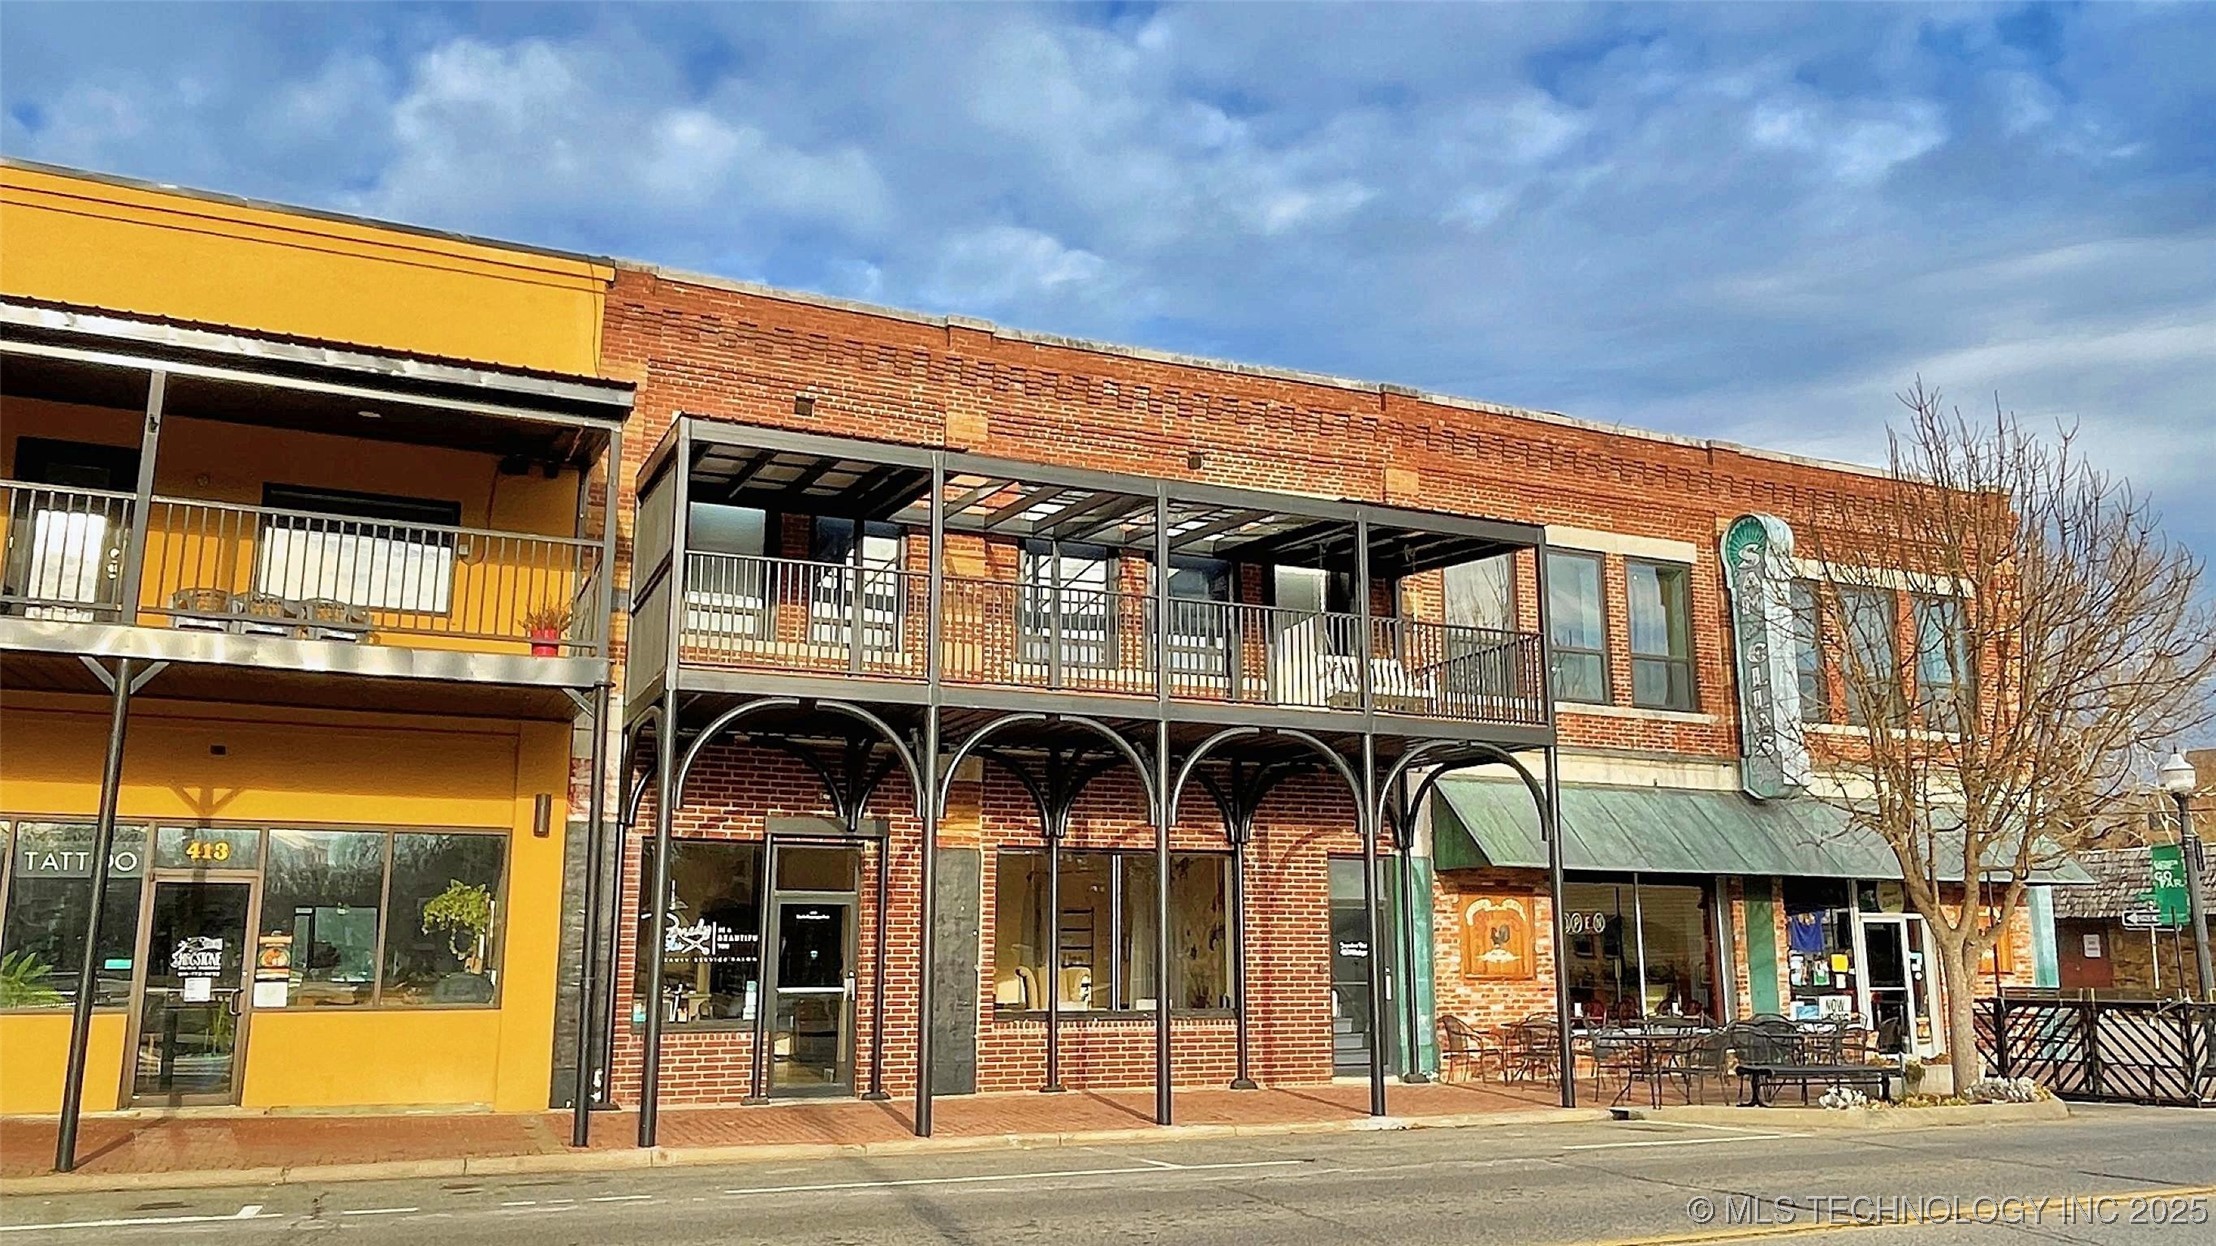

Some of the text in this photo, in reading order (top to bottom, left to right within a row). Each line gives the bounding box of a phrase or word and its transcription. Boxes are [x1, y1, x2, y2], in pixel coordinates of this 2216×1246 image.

[24, 851, 138, 872] TATTO
[185, 840, 230, 862] 413
[717, 934, 758, 942] BEAUTIFU
